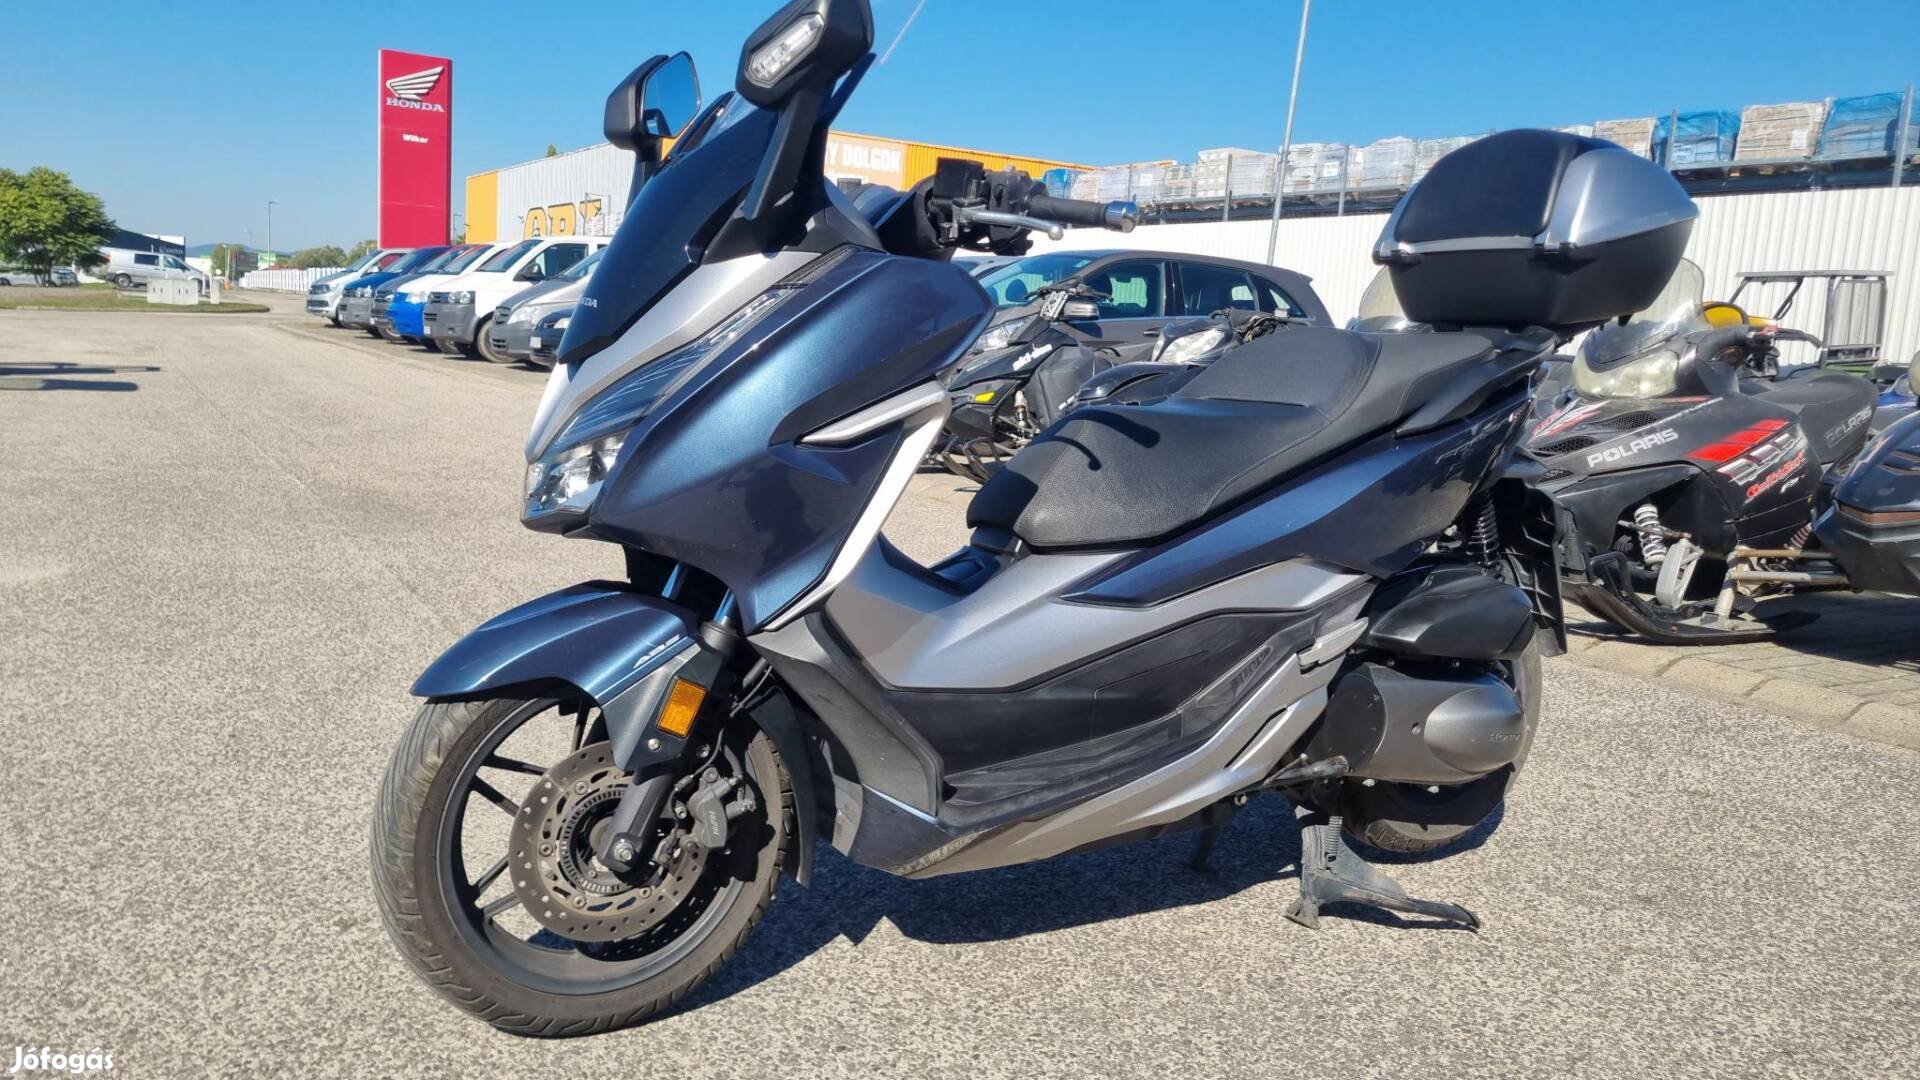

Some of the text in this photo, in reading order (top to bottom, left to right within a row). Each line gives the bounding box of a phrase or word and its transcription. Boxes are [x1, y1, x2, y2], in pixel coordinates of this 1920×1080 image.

[385, 98, 445, 113] HONDA
[842, 143, 903, 174] DOLGOK
[1586, 428, 1679, 468] POLARIS
